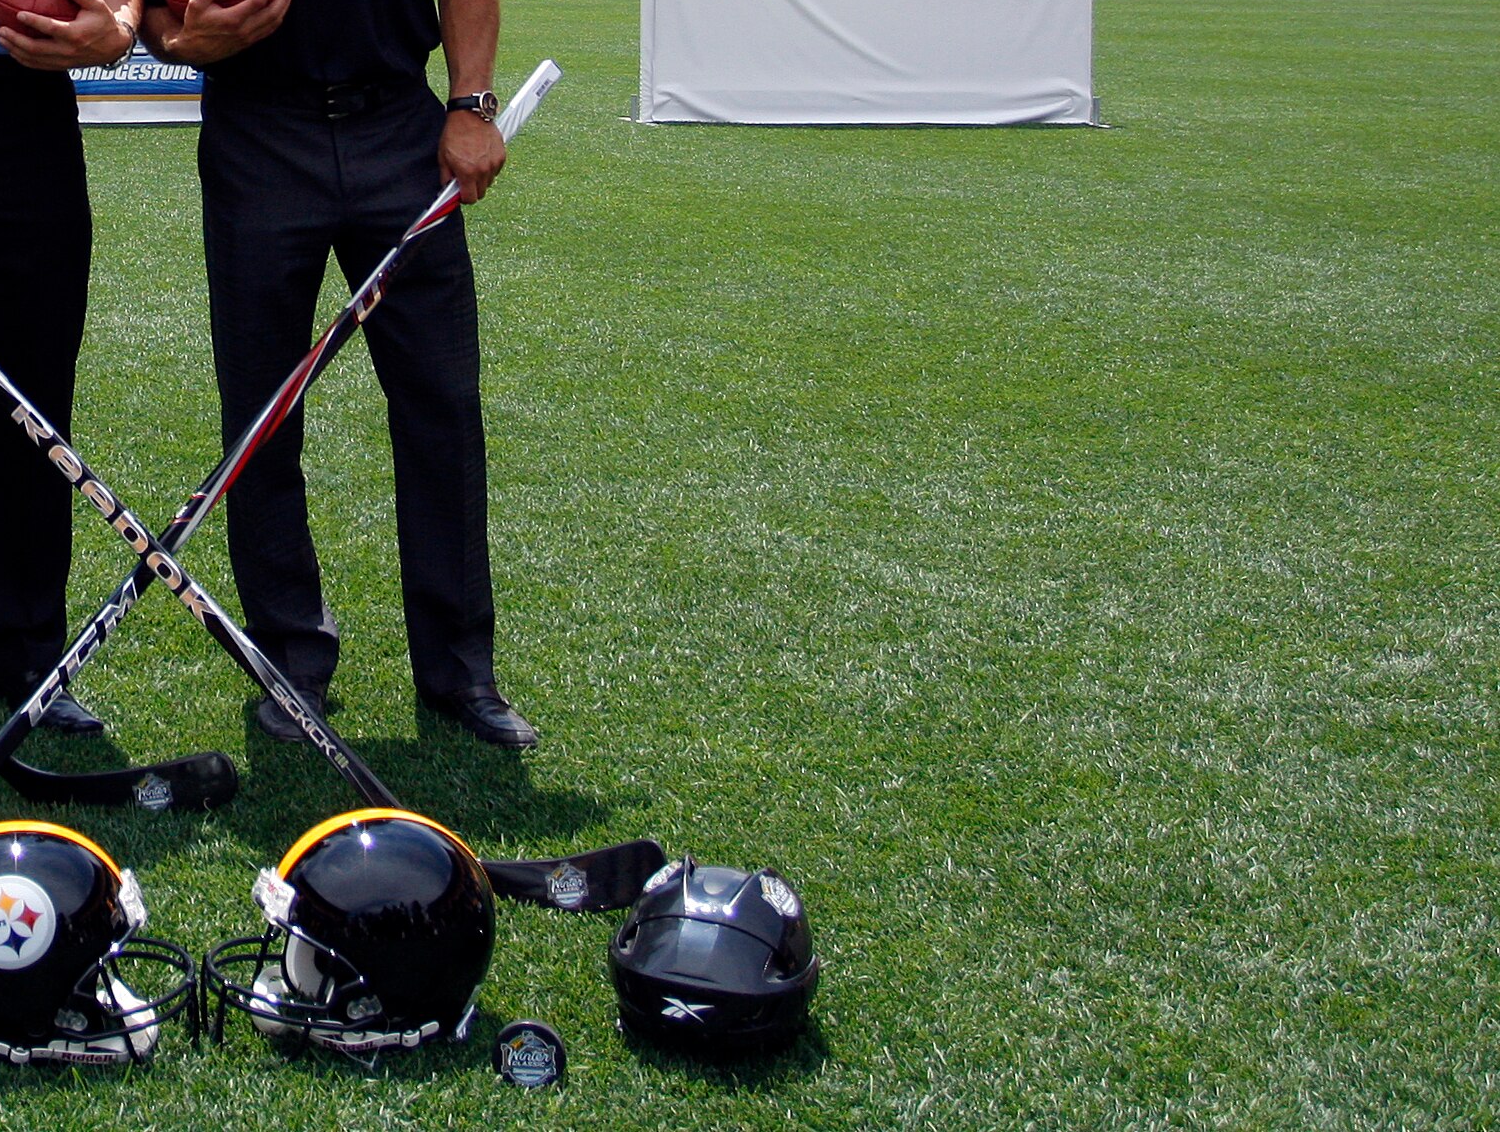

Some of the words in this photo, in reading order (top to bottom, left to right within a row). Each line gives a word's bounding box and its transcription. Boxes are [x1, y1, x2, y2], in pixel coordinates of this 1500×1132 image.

[21, 577, 138, 728] CCM
[270, 682, 337, 756] SICKICK
[62, 1052, 114, 1062] Riddell
[506, 1045, 551, 1066] Winter
